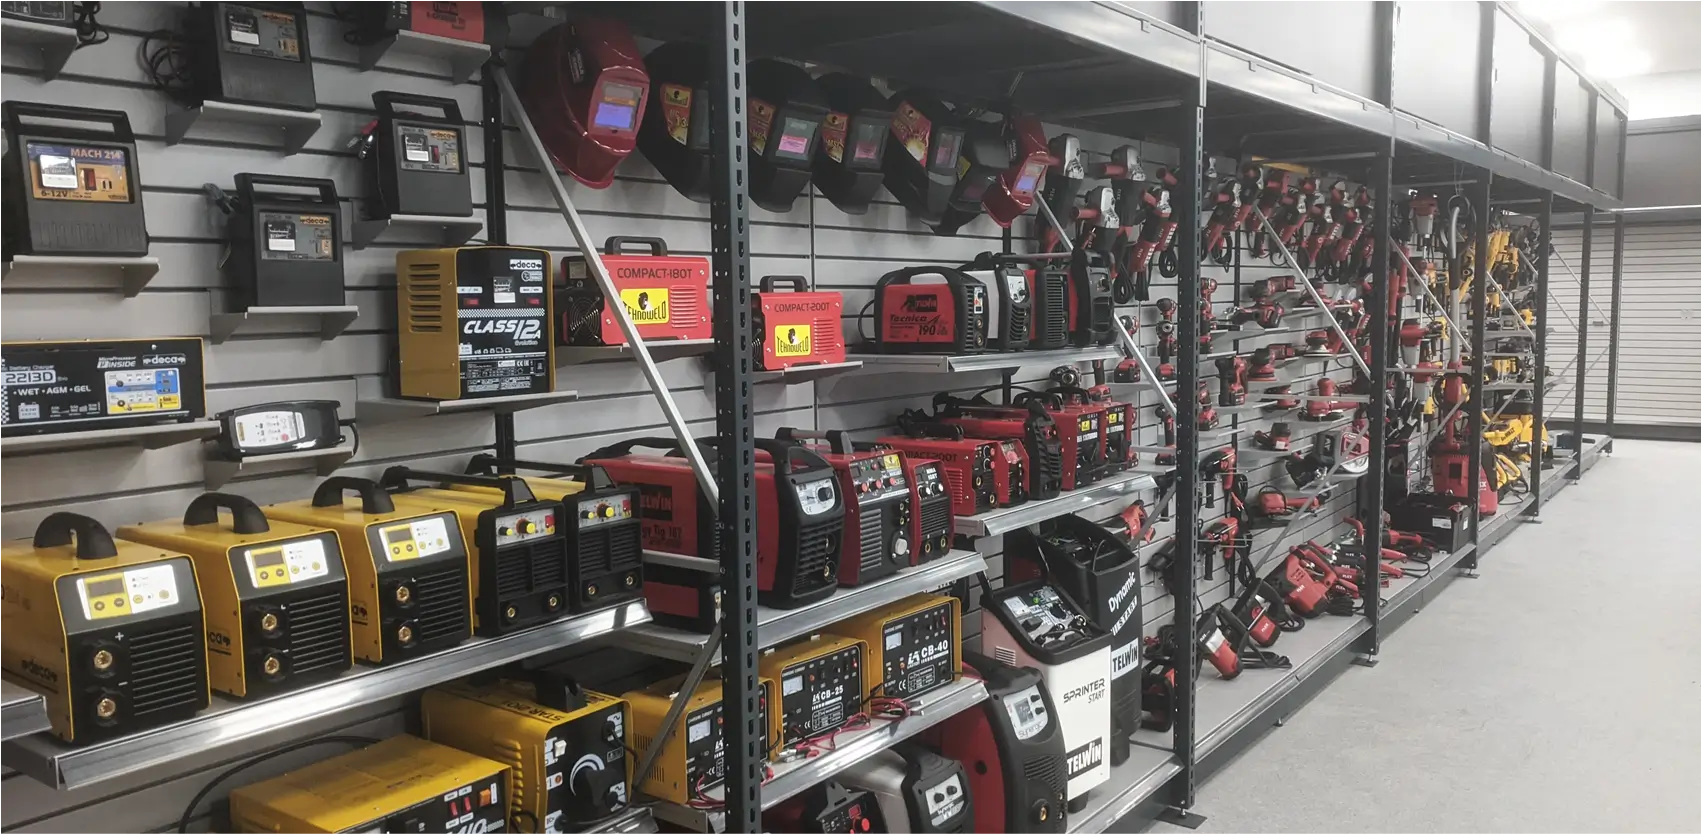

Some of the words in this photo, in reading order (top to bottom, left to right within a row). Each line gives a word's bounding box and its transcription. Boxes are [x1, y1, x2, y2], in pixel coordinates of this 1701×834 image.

[70, 147, 102, 158] MACH
[41, 189, 68, 198] 6-12V
[516, 260, 536, 269] deca
[774, 302, 830, 313] COMPACT-200T
[463, 320, 518, 335] CLASS
[918, 324, 936, 336] 190
[151, 354, 178, 364] deca
[5, 371, 54, 383] 2213D
[17, 388, 40, 396] WET
[46, 386, 68, 395] AGM
[74, 385, 92, 393] GEL
[1108, 571, 1136, 613] Dynamic
[921, 639, 949, 658] CB-40
[1112, 643, 1138, 673] TELWIN
[898, 679, 907, 691] CE
[1063, 678, 1105, 704] SPRINTER
[820, 684, 844, 701] CB-25
[1088, 689, 1105, 704] START
[529, 708, 564, 721] STAR
[1067, 742, 1102, 776] TELWIN
